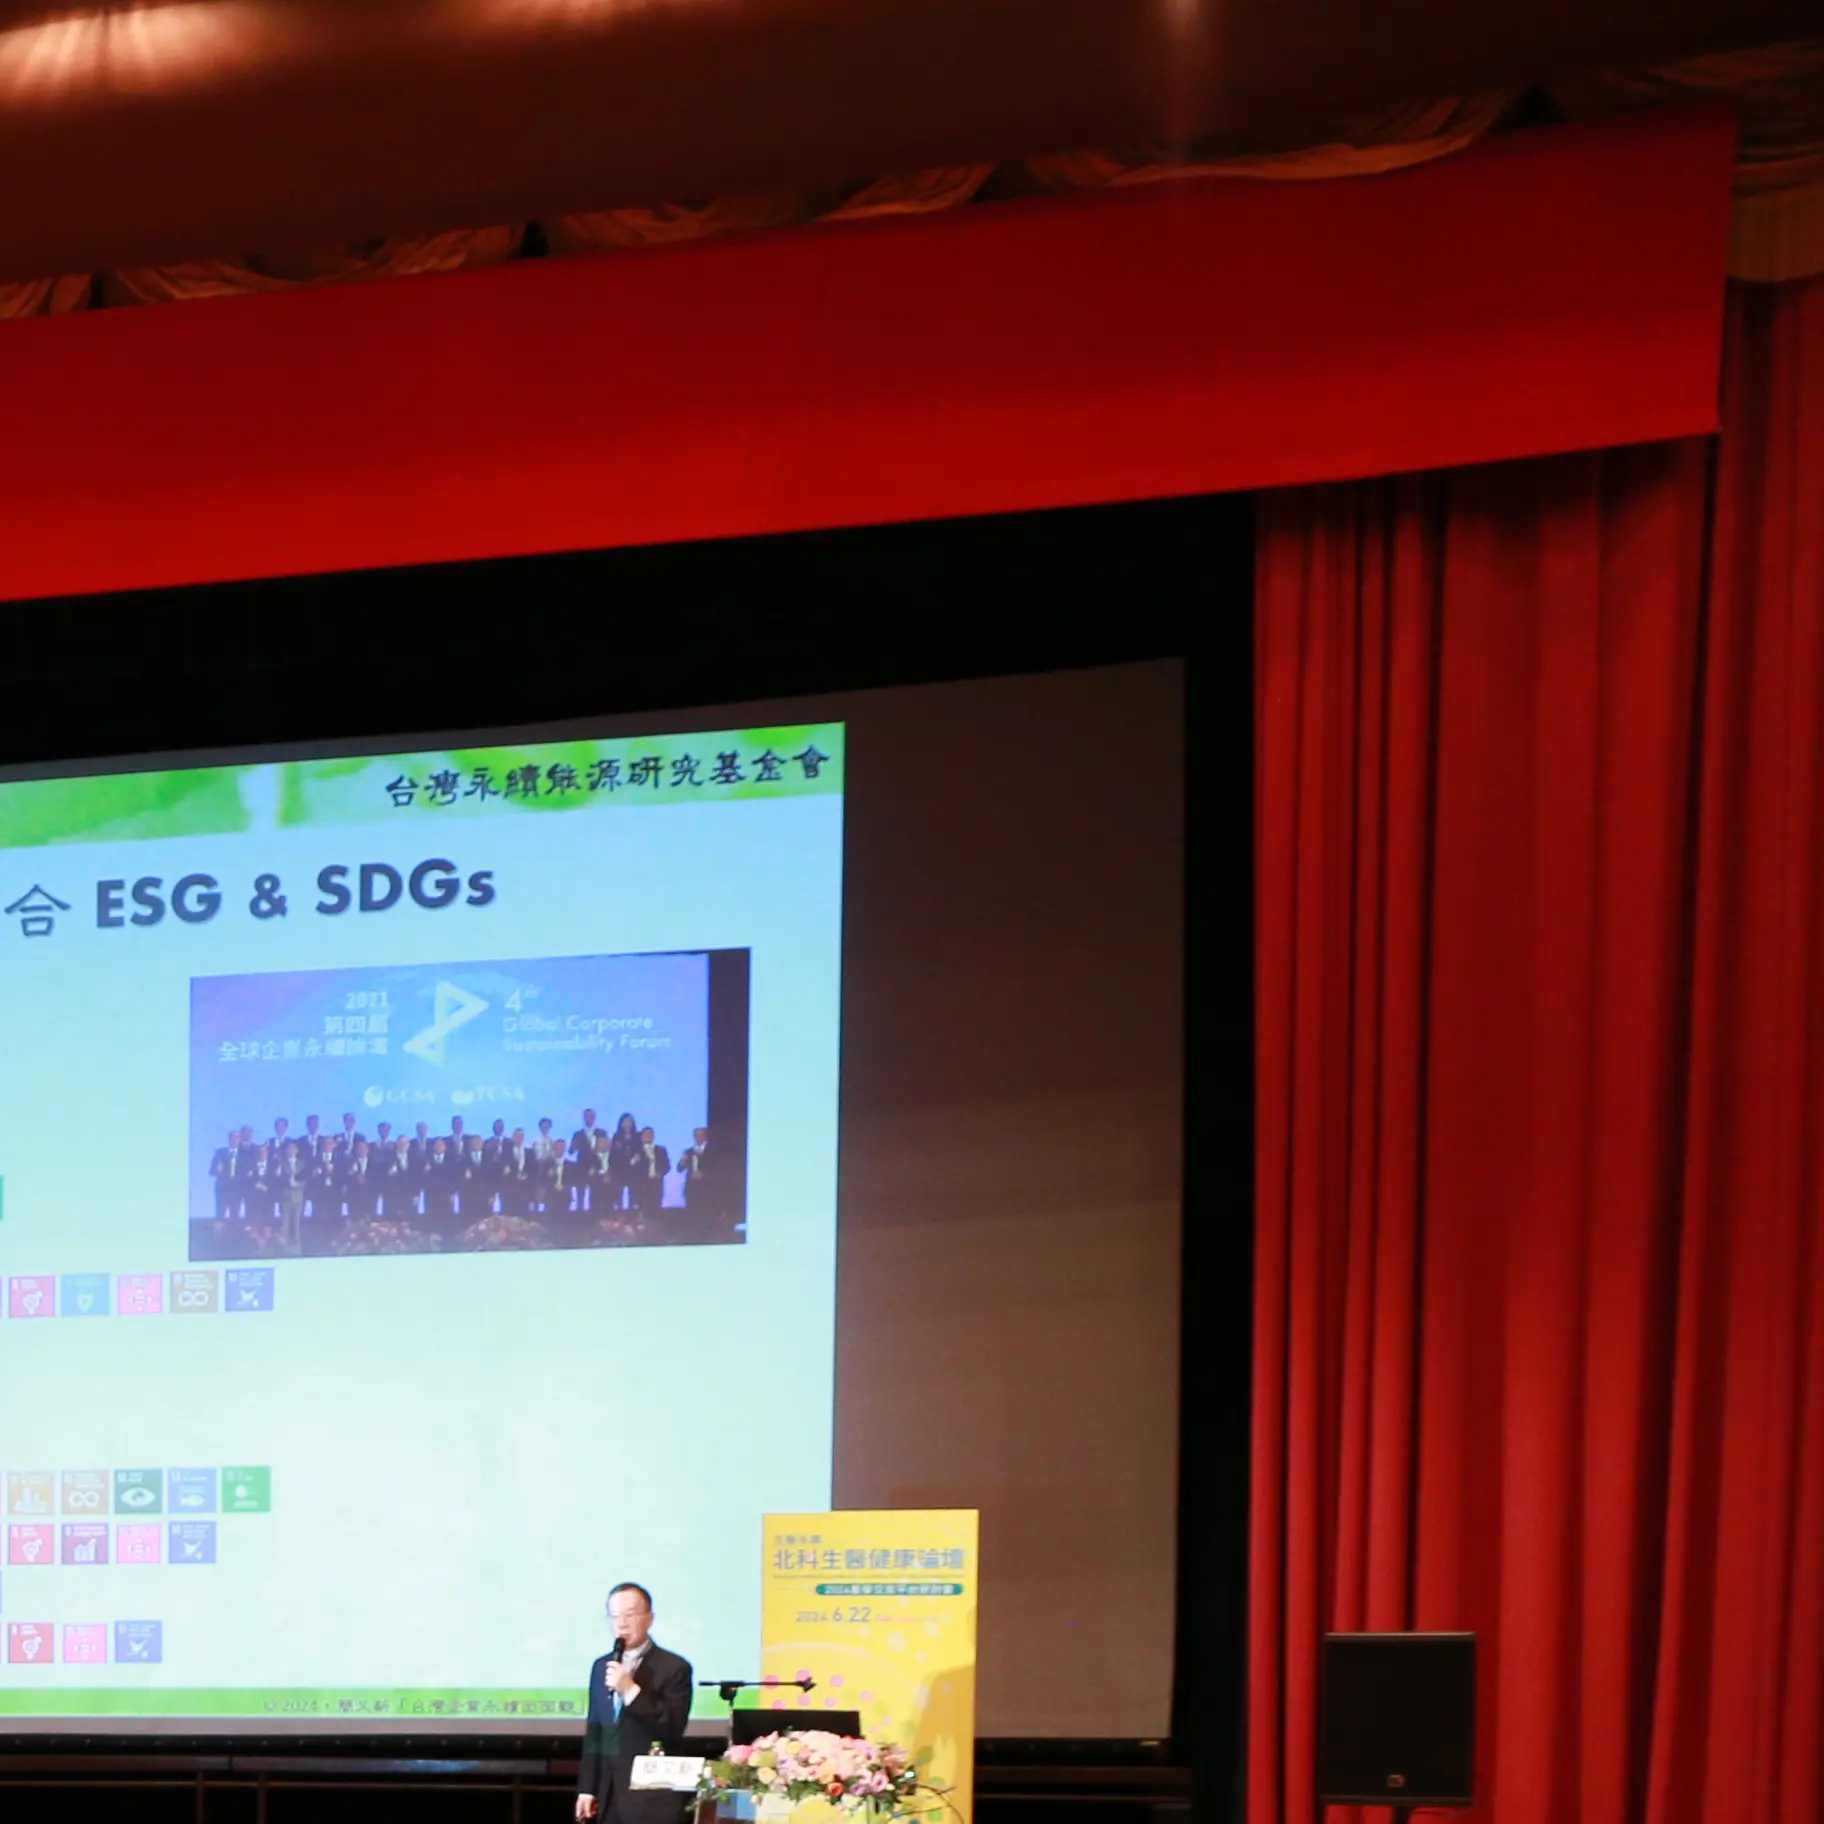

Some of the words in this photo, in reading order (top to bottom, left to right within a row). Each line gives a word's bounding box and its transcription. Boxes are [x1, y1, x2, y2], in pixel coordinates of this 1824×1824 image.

[385, 744, 830, 807] 台灣永續能源研究基金會
[96, 873, 222, 928] ESG
[249, 872, 288, 919] &
[315, 858, 496, 916] SDGs
